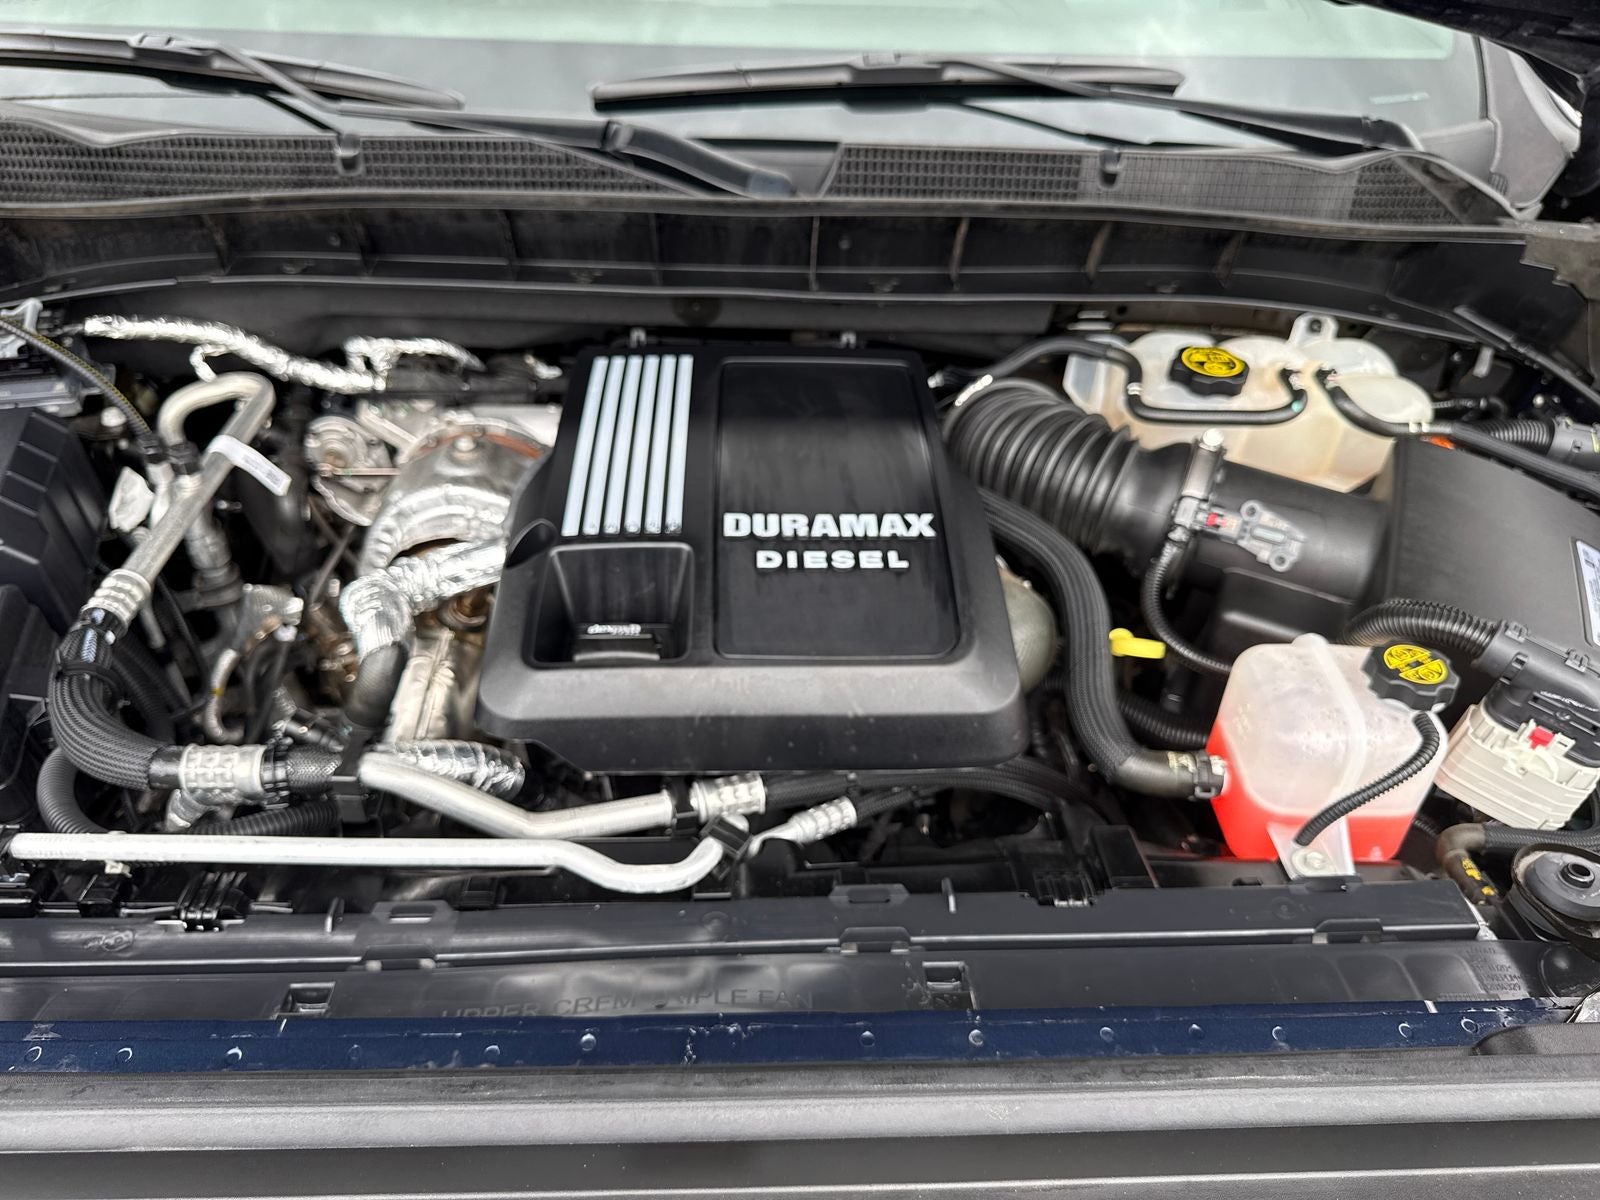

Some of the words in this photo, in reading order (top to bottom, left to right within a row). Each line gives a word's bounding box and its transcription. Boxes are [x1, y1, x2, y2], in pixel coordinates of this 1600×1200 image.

[722, 512, 937, 538] DURAMAX
[755, 549, 910, 570] DIESEL
[650, 988, 748, 1008] IPLE
[758, 989, 814, 1010] FAN
